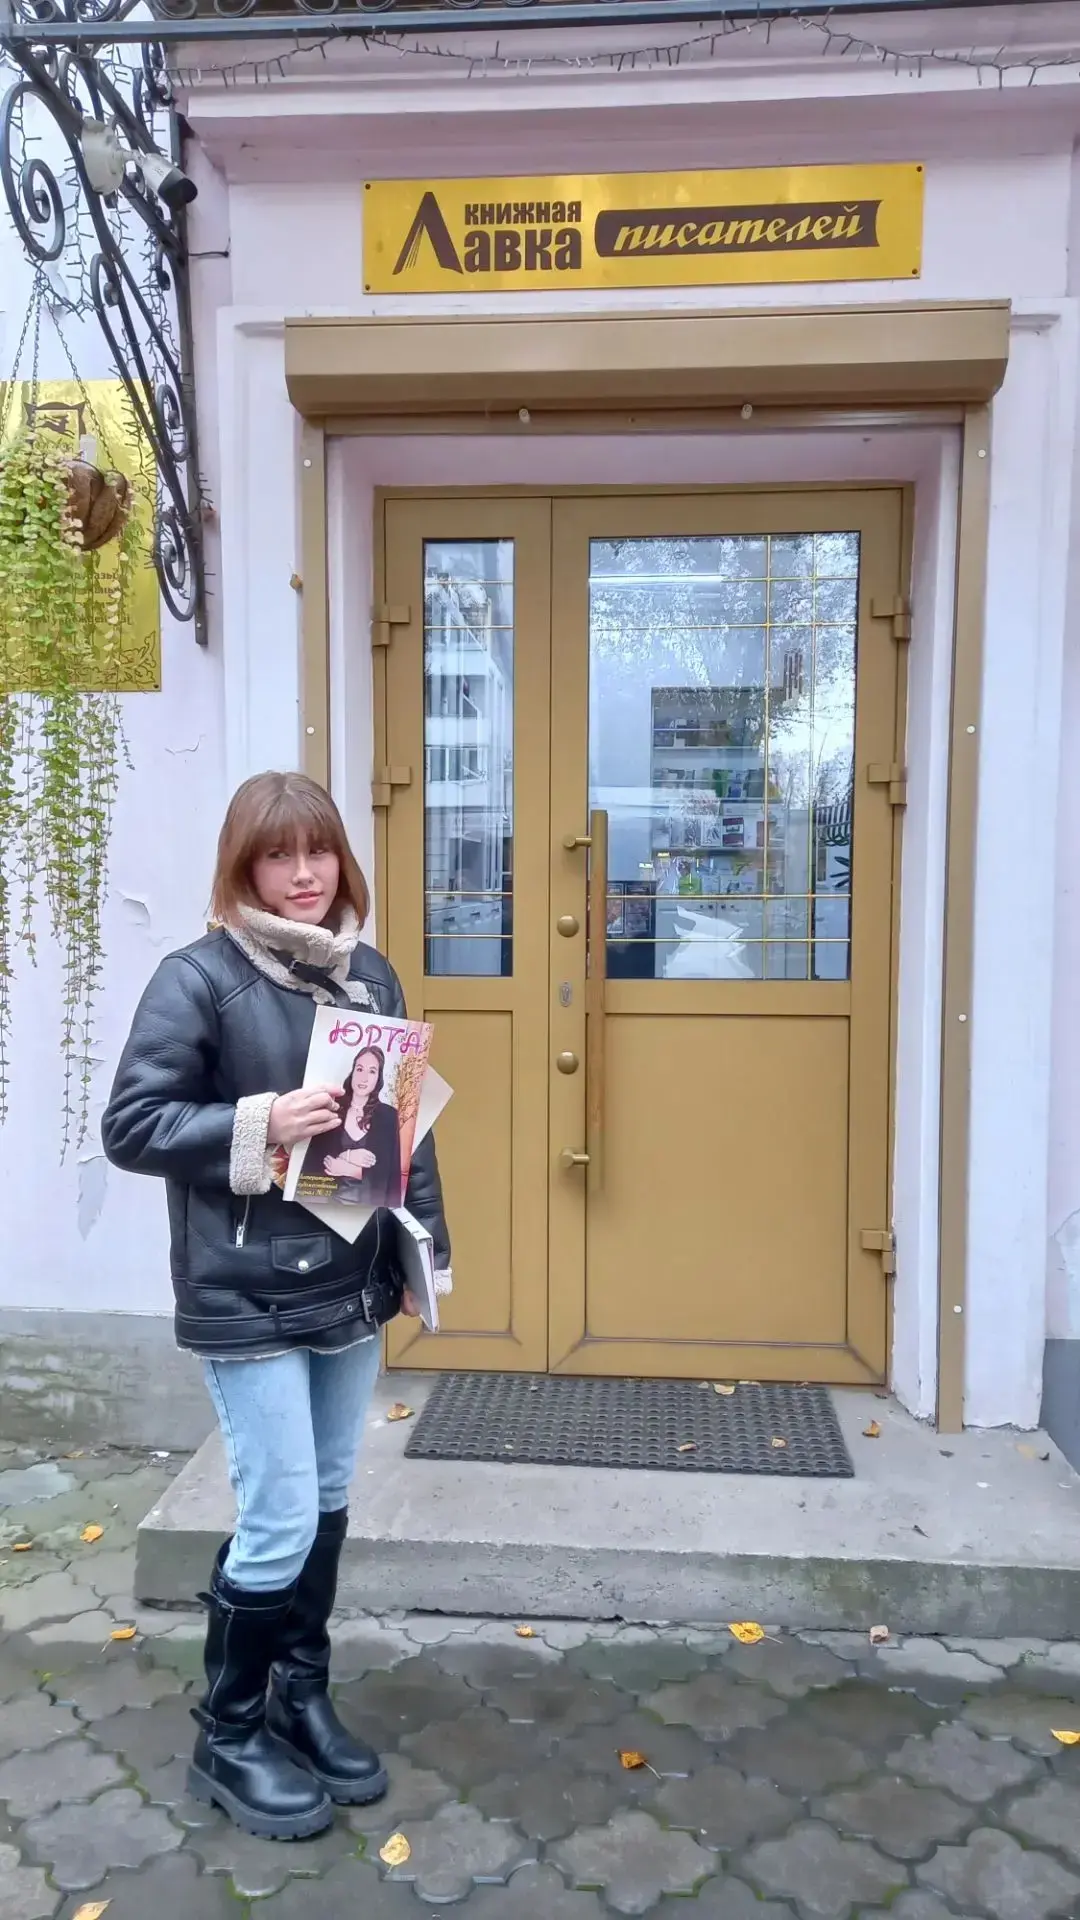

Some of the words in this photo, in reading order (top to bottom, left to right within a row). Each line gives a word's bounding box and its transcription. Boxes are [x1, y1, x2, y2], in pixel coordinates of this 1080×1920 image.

[392, 191, 582, 275] Лавка
[464, 201, 582, 226] книжная
[613, 204, 864, 251] писателей
[328, 1019, 424, 1055] ЮРТА
